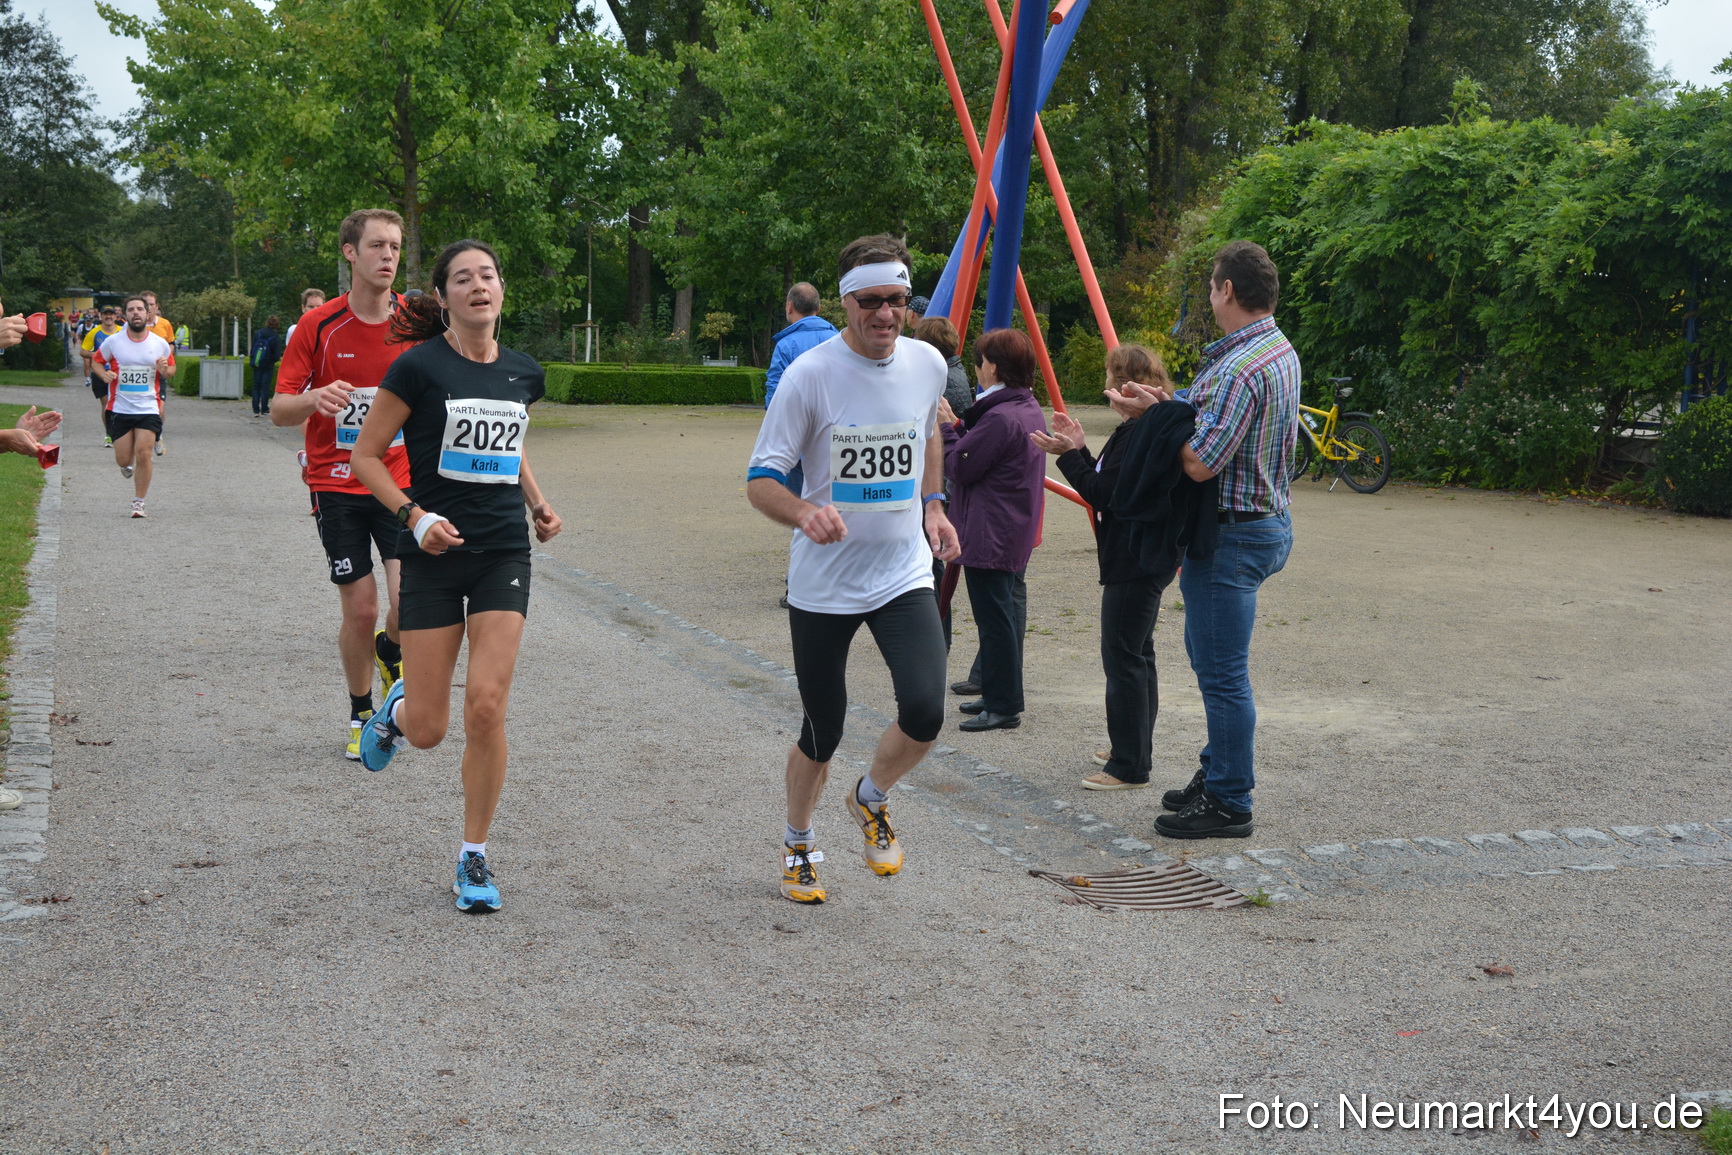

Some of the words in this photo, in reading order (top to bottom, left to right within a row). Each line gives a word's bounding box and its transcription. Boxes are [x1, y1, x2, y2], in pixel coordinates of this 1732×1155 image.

[121, 372, 148, 384] 3425
[343, 402, 370, 426] 23
[449, 406, 478, 415] PARTL
[479, 407, 517, 418] Neumarkt
[345, 431, 358, 441] Fra
[452, 418, 520, 452] 2022
[832, 434, 863, 443] PARTL
[865, 432, 906, 442] Neumarkt
[471, 458, 499, 472] Karla
[840, 443, 913, 480] 2389
[330, 462, 351, 479] 29
[863, 487, 892, 500] Hans
[334, 557, 353, 576] 29
